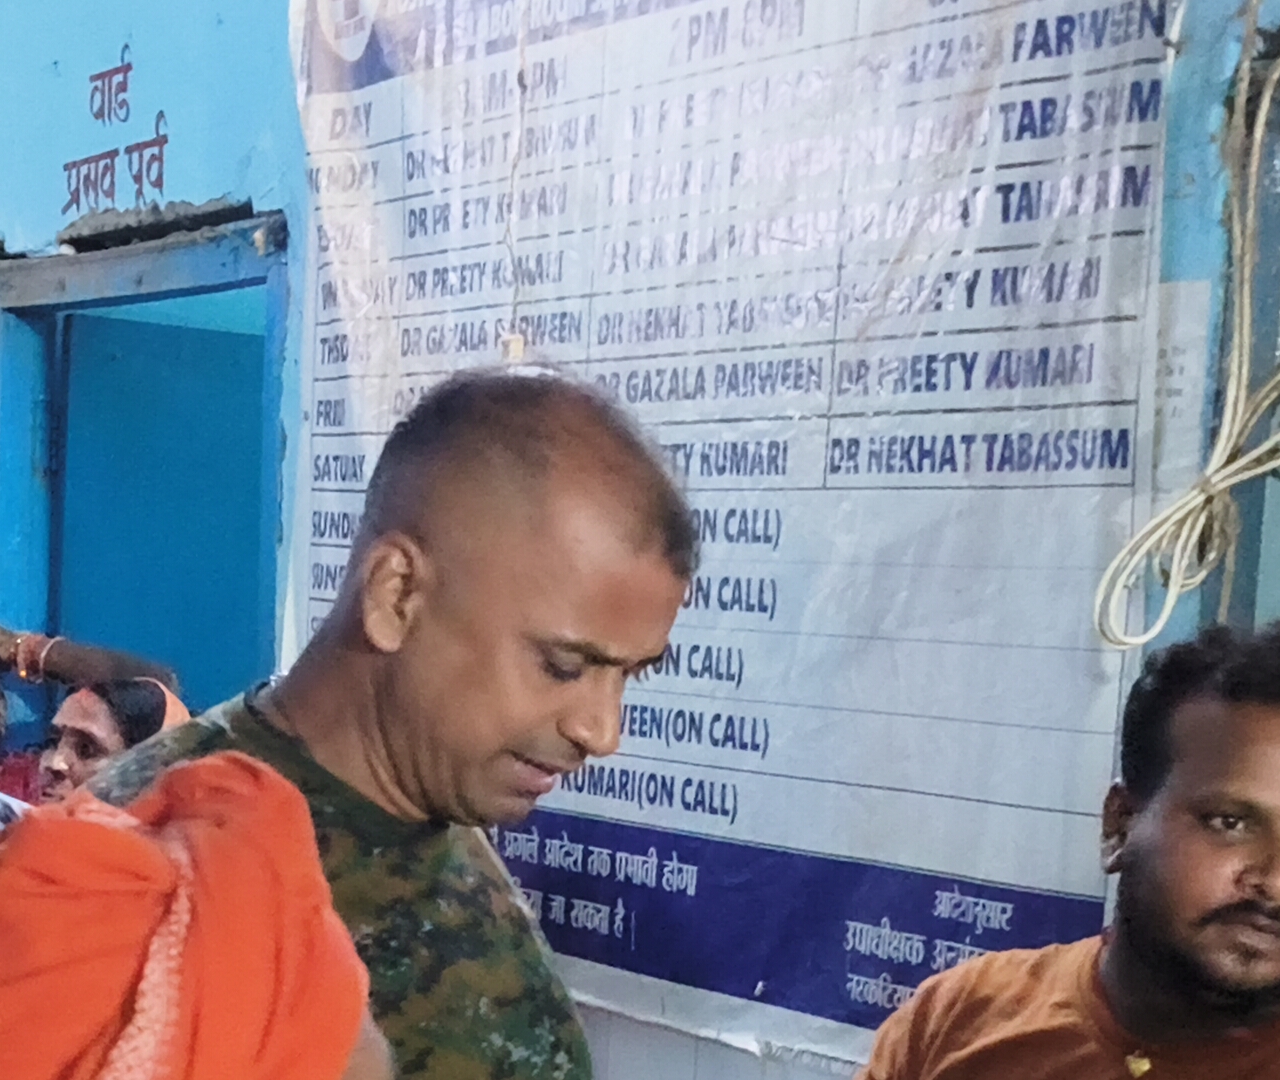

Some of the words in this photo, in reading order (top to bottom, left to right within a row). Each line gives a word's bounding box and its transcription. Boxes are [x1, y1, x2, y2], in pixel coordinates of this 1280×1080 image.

[89, 43, 133, 127] वार्ड
[330, 102, 372, 141] DAY
[61, 148, 119, 215] प्रसव
[124, 110, 168, 207] पूर्व
[408, 207, 428, 239] DR
[433, 200, 491, 236] PRETY
[406, 270, 428, 301] DR
[401, 328, 422, 357] DR
[426, 320, 488, 356] GAALA
[495, 311, 582, 350] PRWEEN
[628, 303, 704, 343] NEKHT
[626, 365, 706, 403] GAZALA
[713, 357, 824, 400] PARWEEN
[700, 440, 788, 477] KUMARI
[828, 438, 861, 475] DR
[867, 434, 978, 474] NEKHAT
[982, 428, 1130, 472] TABASSUM
[724, 508, 782, 551] CALL)
[717, 576, 777, 621] CALL)
[687, 645, 744, 690] CALL)
[709, 713, 769, 760] CALL)
[680, 777, 738, 826] CALL)
[545, 830, 584, 873] आदेश
[587, 845, 613, 878] तक
[614, 847, 658, 888] प्रभावी
[662, 851, 698, 896] होगा
[548, 894, 566, 925] जा
[571, 898, 611, 936] सकता
[932, 884, 1014, 935] आदेशानुसार
[844, 916, 927, 966] उपाधीक्षक
